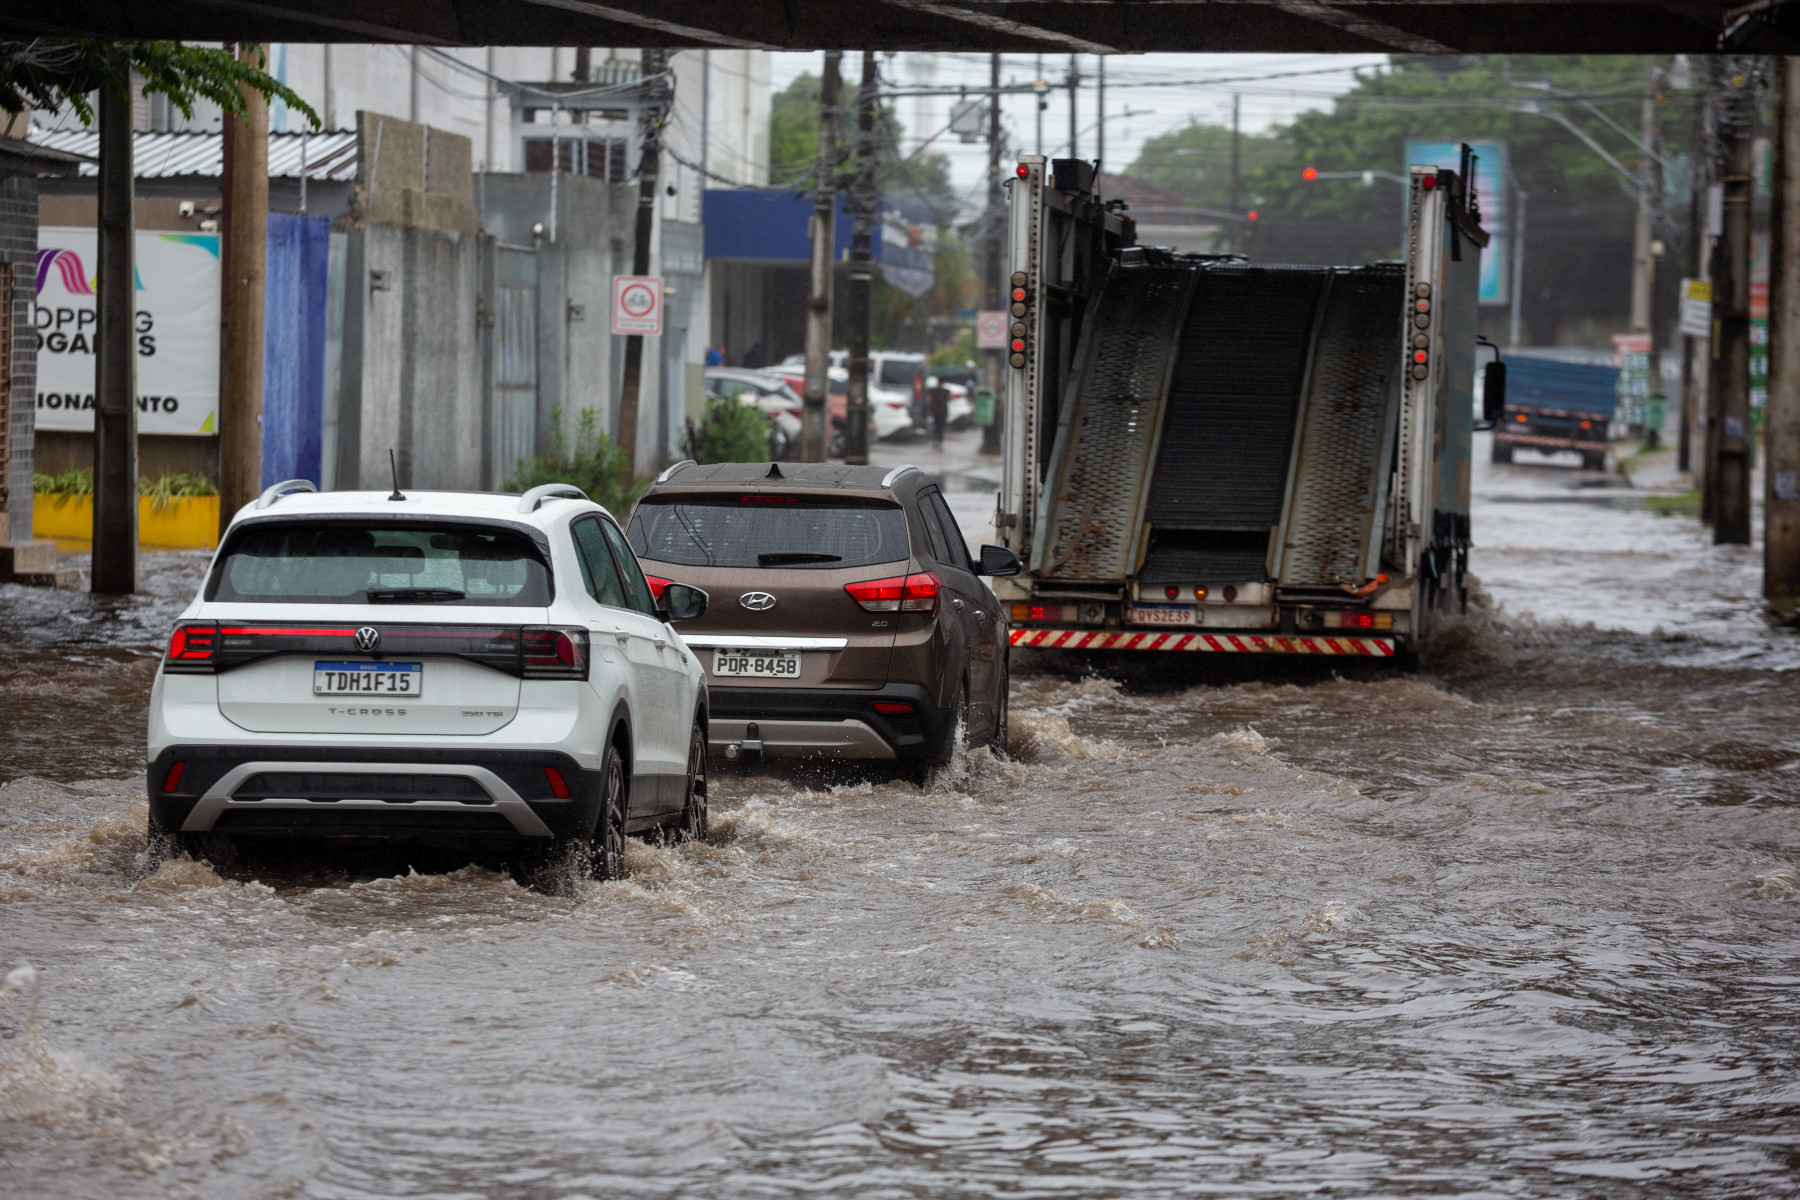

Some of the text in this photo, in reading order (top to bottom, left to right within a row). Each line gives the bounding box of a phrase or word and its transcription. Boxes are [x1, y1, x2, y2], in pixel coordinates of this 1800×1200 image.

[37, 392, 179, 413] IONANTO
[325, 672, 410, 692] TDH1F15
[328, 707, 407, 716] T-CROSS
